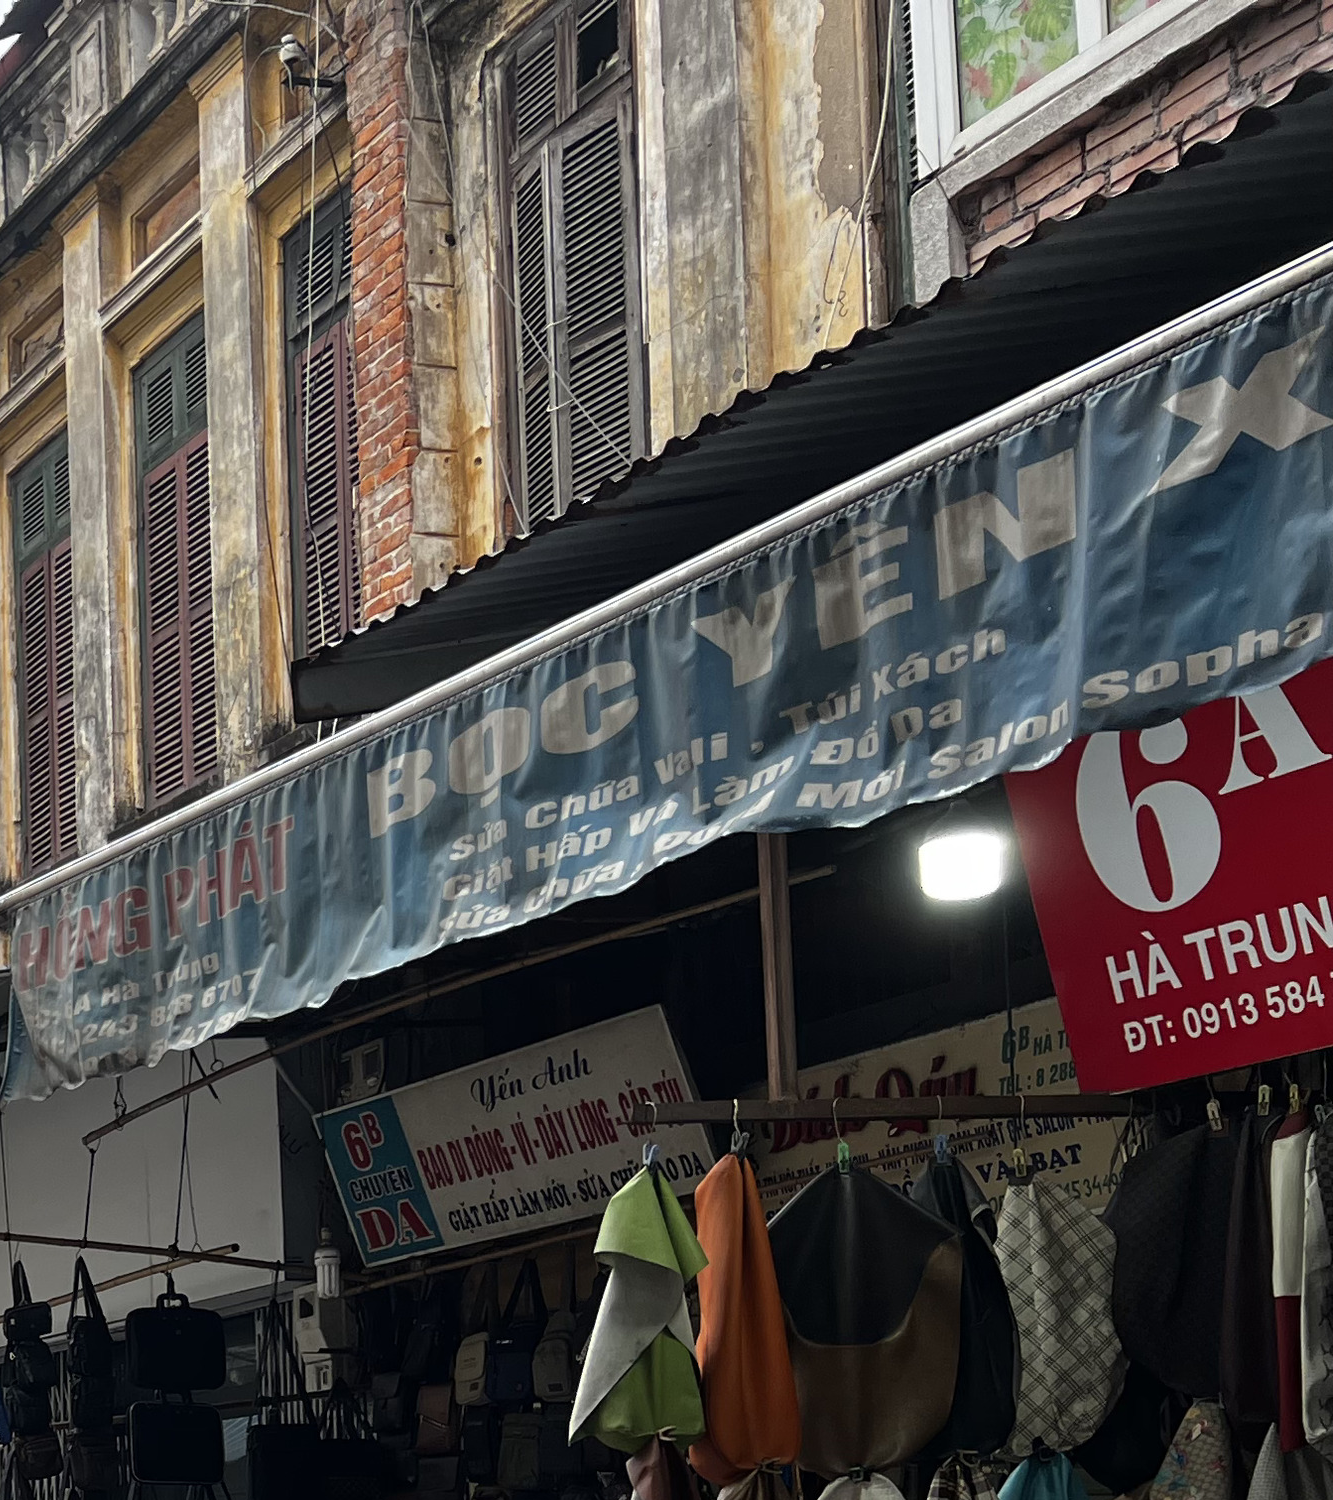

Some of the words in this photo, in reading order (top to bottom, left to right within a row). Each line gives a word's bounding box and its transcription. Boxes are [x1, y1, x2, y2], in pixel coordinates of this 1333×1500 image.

[366, 660, 640, 838] BỌC
[690, 450, 1076, 687] YÊN
[927, 699, 1069, 780] Salon
[1082, 612, 1323, 710] Sopha
[448, 817, 508, 862] Sửa
[524, 774, 640, 829] Chữa
[654, 732, 728, 785] Vali
[779, 683, 861, 734] Túi
[525, 822, 612, 873] Hấp
[890, 698, 962, 744] Da
[1076, 685, 1332, 912] 6A
[162, 814, 295, 940] PHÁT
[1105, 930, 1182, 1004] HÀ
[1124, 1014, 1177, 1053] ĐT:
[1182, 992, 1260, 1039] 0913
[1267, 975, 1325, 1020] 584
[471, 1069, 525, 1113] Yến
[532, 1049, 593, 1090] Anh
[341, 1110, 384, 1171] 6B
[417, 1141, 453, 1190] BAO
[450, 1137, 472, 1181] DI
[465, 1127, 515, 1184] ĐỘNG
[532, 1103, 574, 1161] DÂY
[567, 1098, 618, 1151] LƯNG
[1030, 1144, 1081, 1174] BẠT
[349, 1164, 412, 1202] CHUYÊN
[448, 1194, 480, 1235] GIẶT
[483, 1178, 511, 1226] HẤP
[514, 1185, 543, 1219] LÀM
[543, 1179, 572, 1214] MỚI
[578, 1168, 611, 1203] SỬA
[678, 1151, 706, 1178] DA
[355, 1200, 433, 1252] DA
